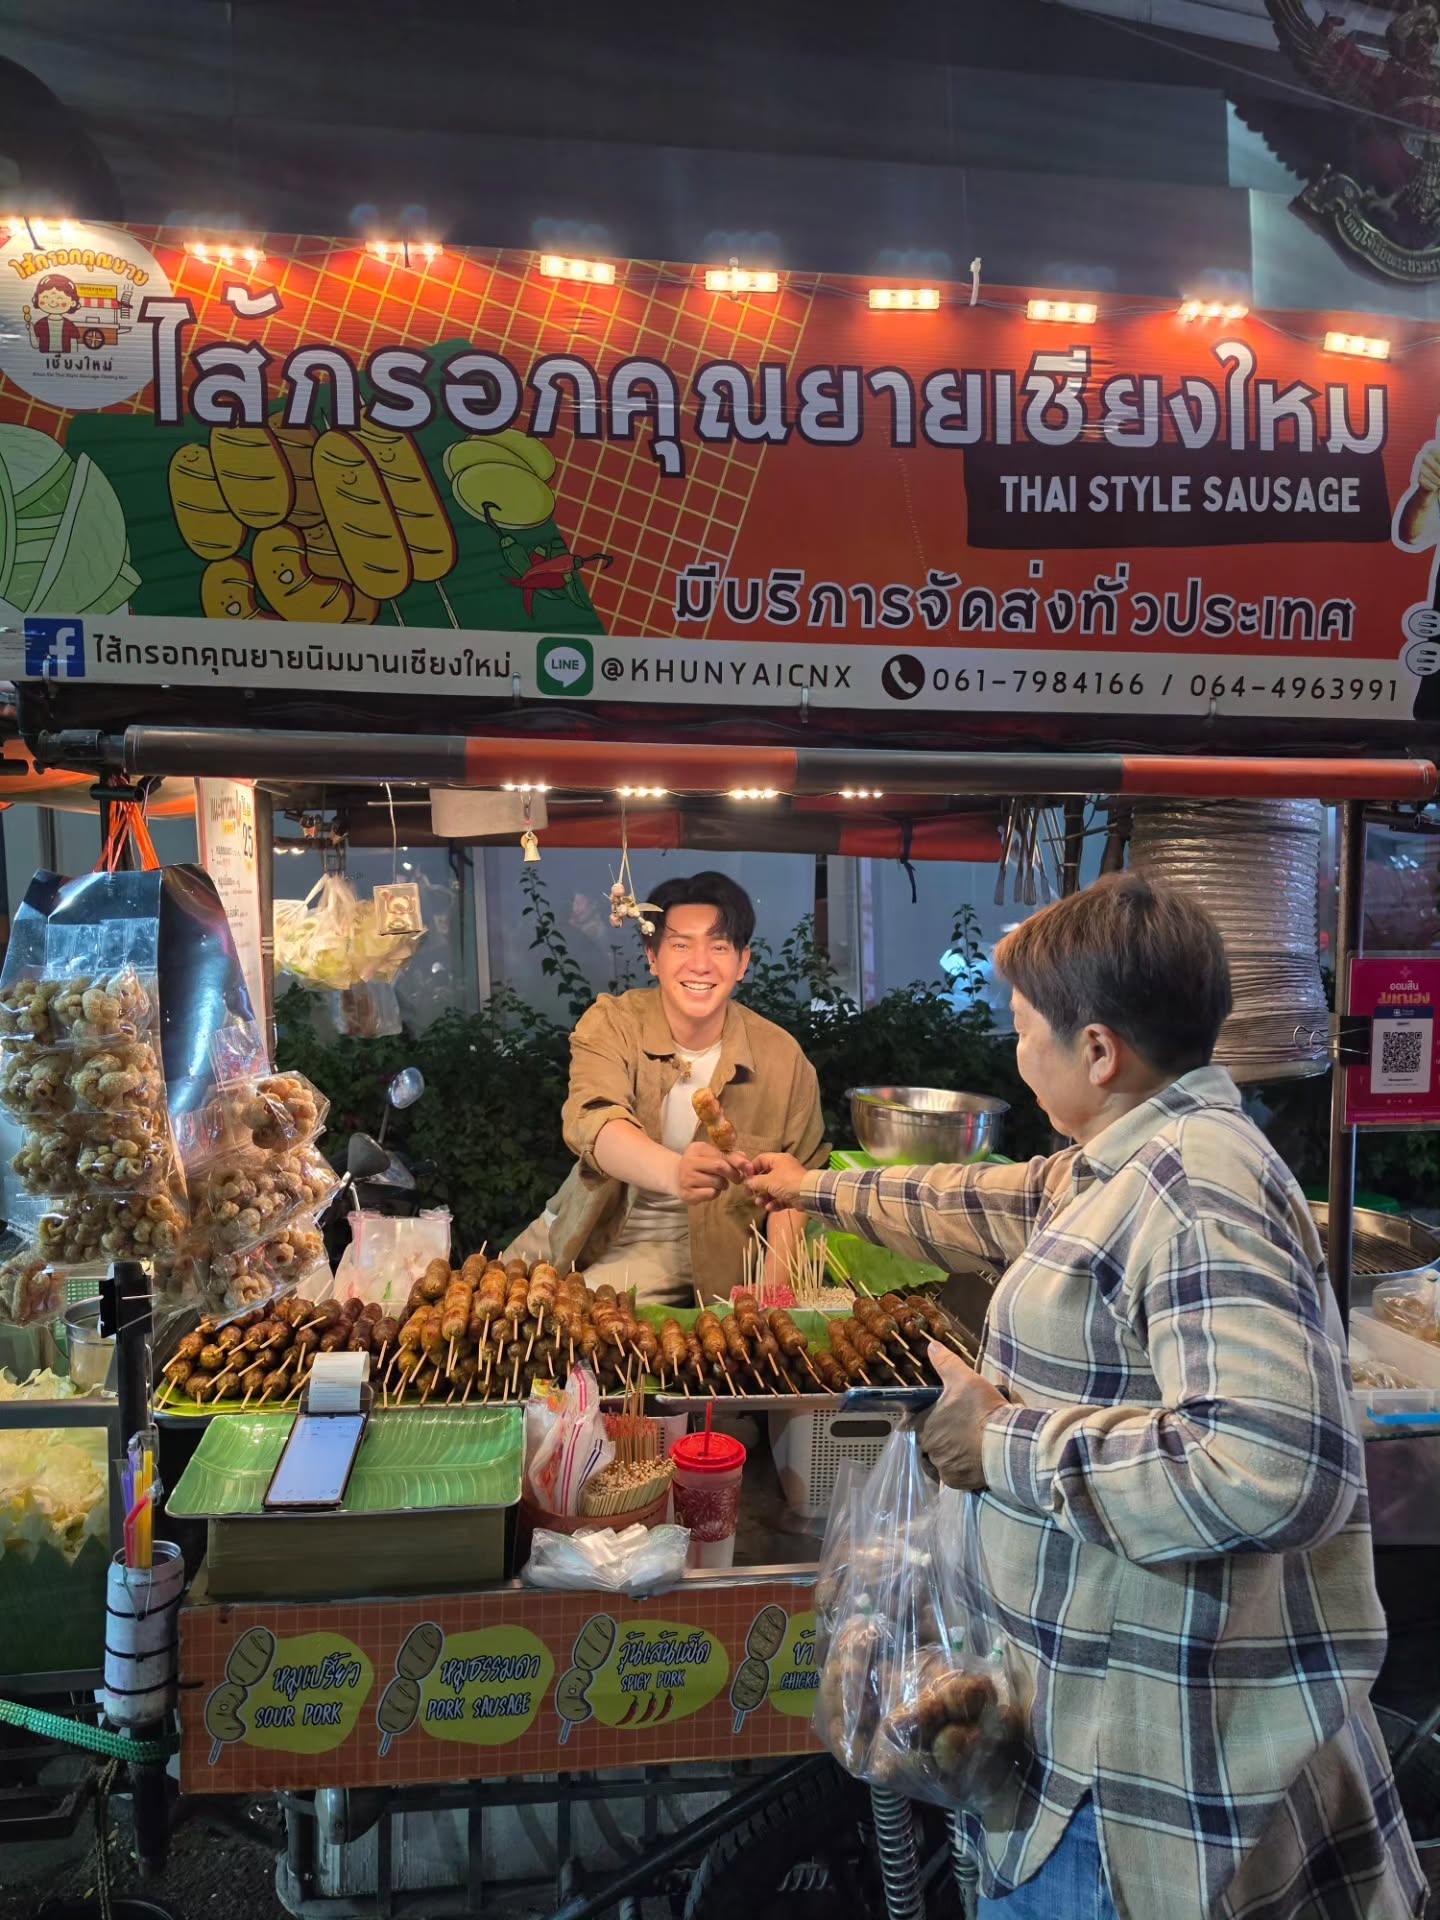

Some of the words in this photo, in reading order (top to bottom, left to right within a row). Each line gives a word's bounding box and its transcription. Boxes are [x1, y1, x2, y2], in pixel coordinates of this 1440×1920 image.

[1000, 475, 1076, 513] THAI
[1088, 475, 1192, 513] STYLE
[1202, 476, 1361, 513] SAUSAGE
[672, 558, 1356, 642] มีบริการจัดส่งทั่วประเทศ
[92, 632, 511, 679] ไส้กรอกคุณยายนิมมานเชียงใหม่
[551, 658, 580, 671] LINE
[601, 656, 852, 689] @KHUNYAICNX
[932, 668, 1145, 696] 061-7984166
[1189, 674, 1398, 702] 064-4963991
[1389, 980, 1419, 991] ออมสิน
[272, 1651, 362, 1702] หมูเปรี้ยว
[440, 1653, 541, 1695] หมูธรรมดา
[621, 1671, 651, 1693] SPICY
[656, 1669, 686, 1689] PORK
[255, 1705, 296, 1729] SOUR
[303, 1702, 344, 1726] PORK
[426, 1697, 466, 1721] PORK
[472, 1692, 531, 1719] SAUSAGE
